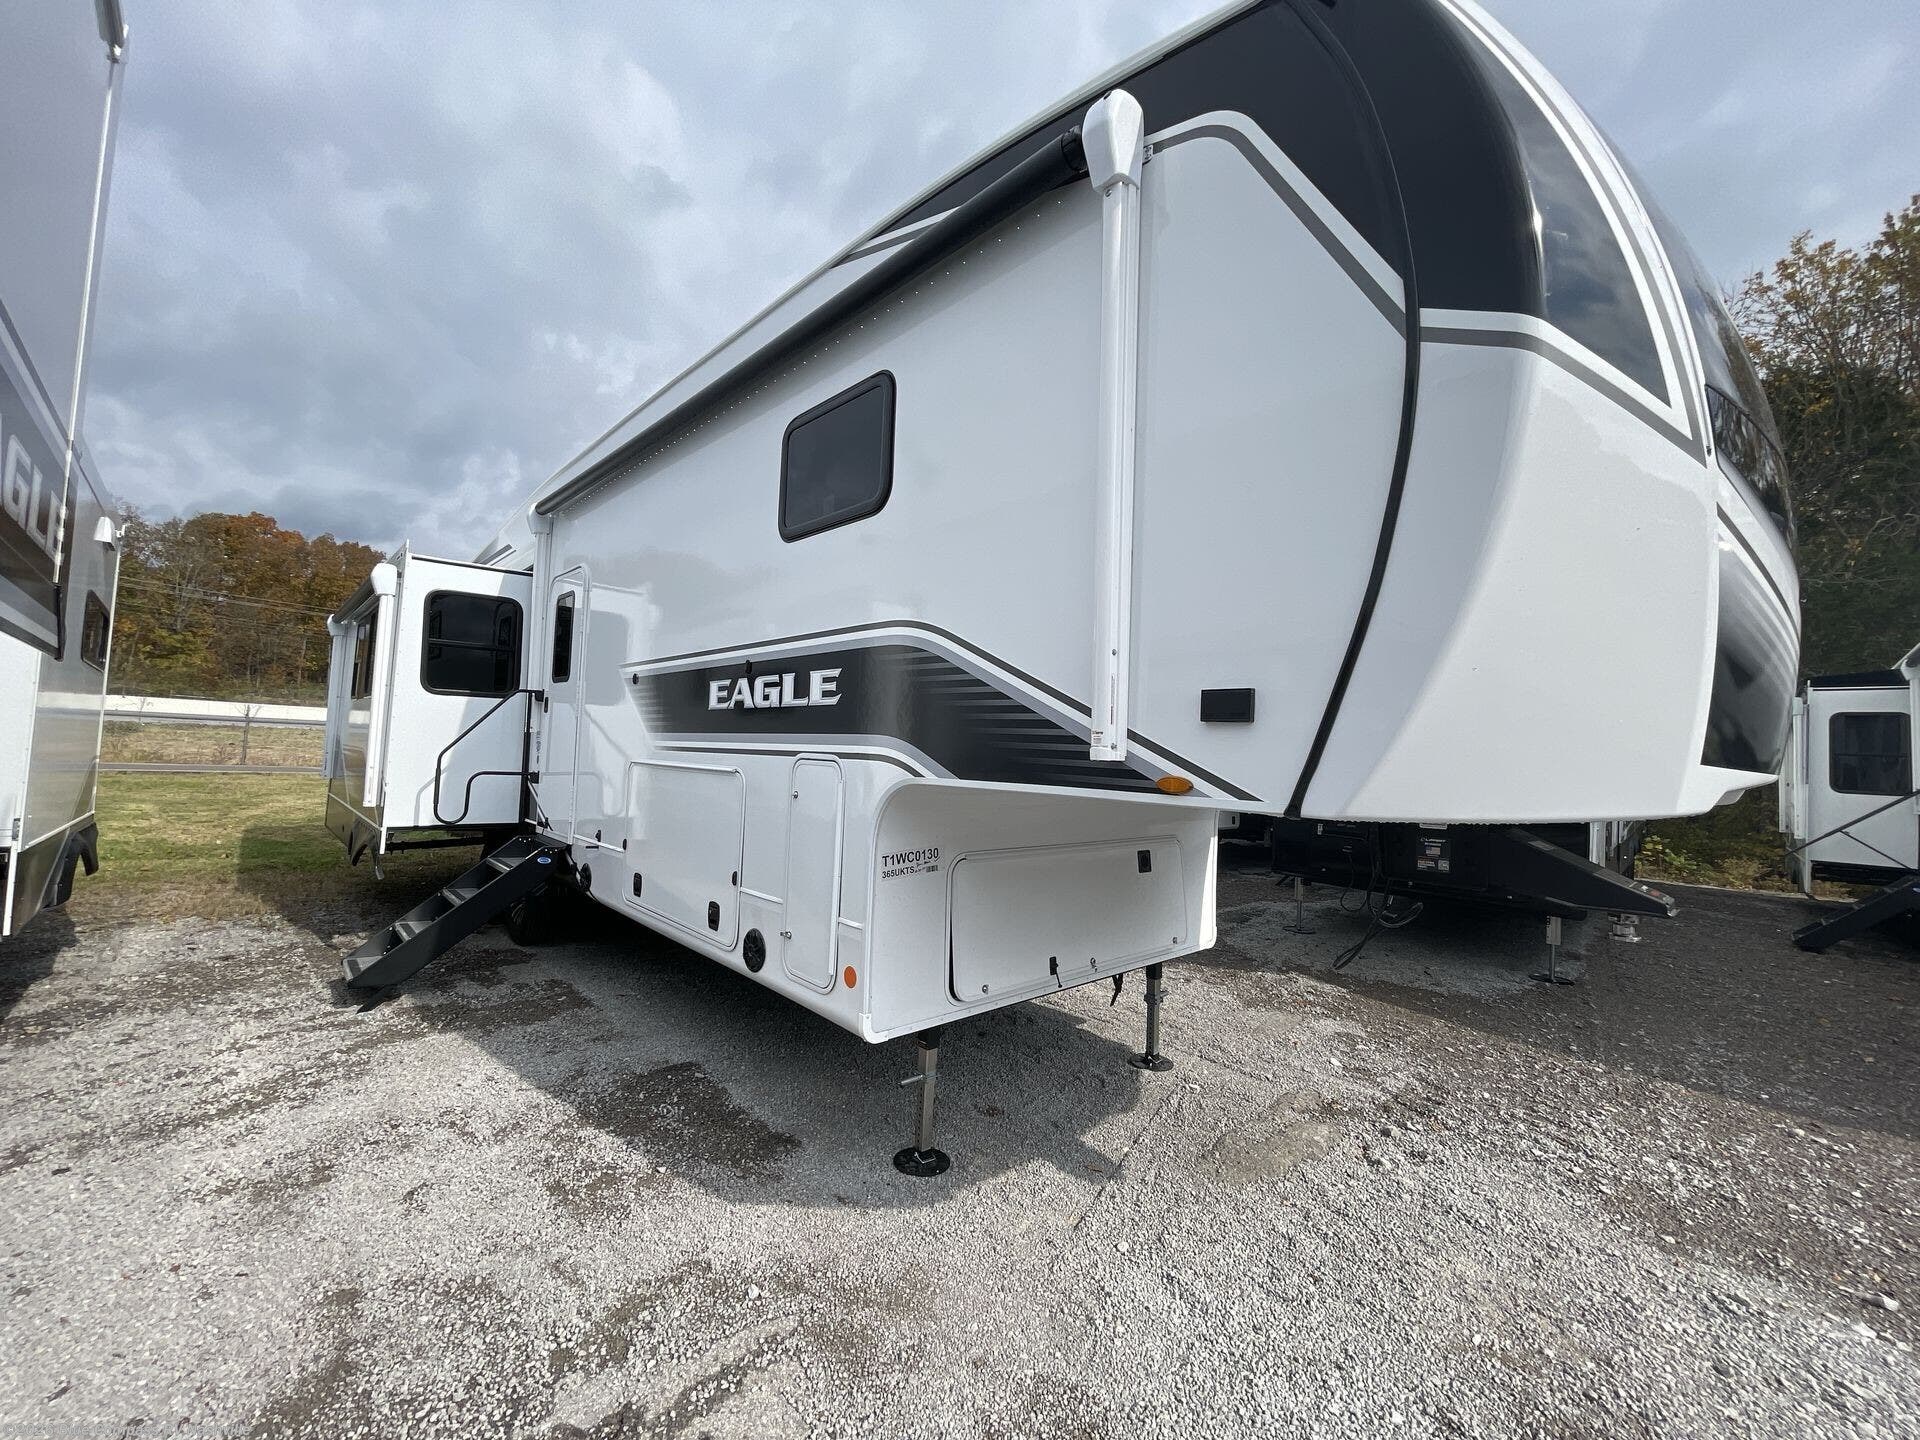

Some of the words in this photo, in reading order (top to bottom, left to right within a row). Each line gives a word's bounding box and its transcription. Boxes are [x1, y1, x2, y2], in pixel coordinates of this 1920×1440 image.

[708, 668, 842, 710] EAGLE
[882, 848, 939, 867] T1WC0130
[882, 866, 915, 879] 365UKTS
